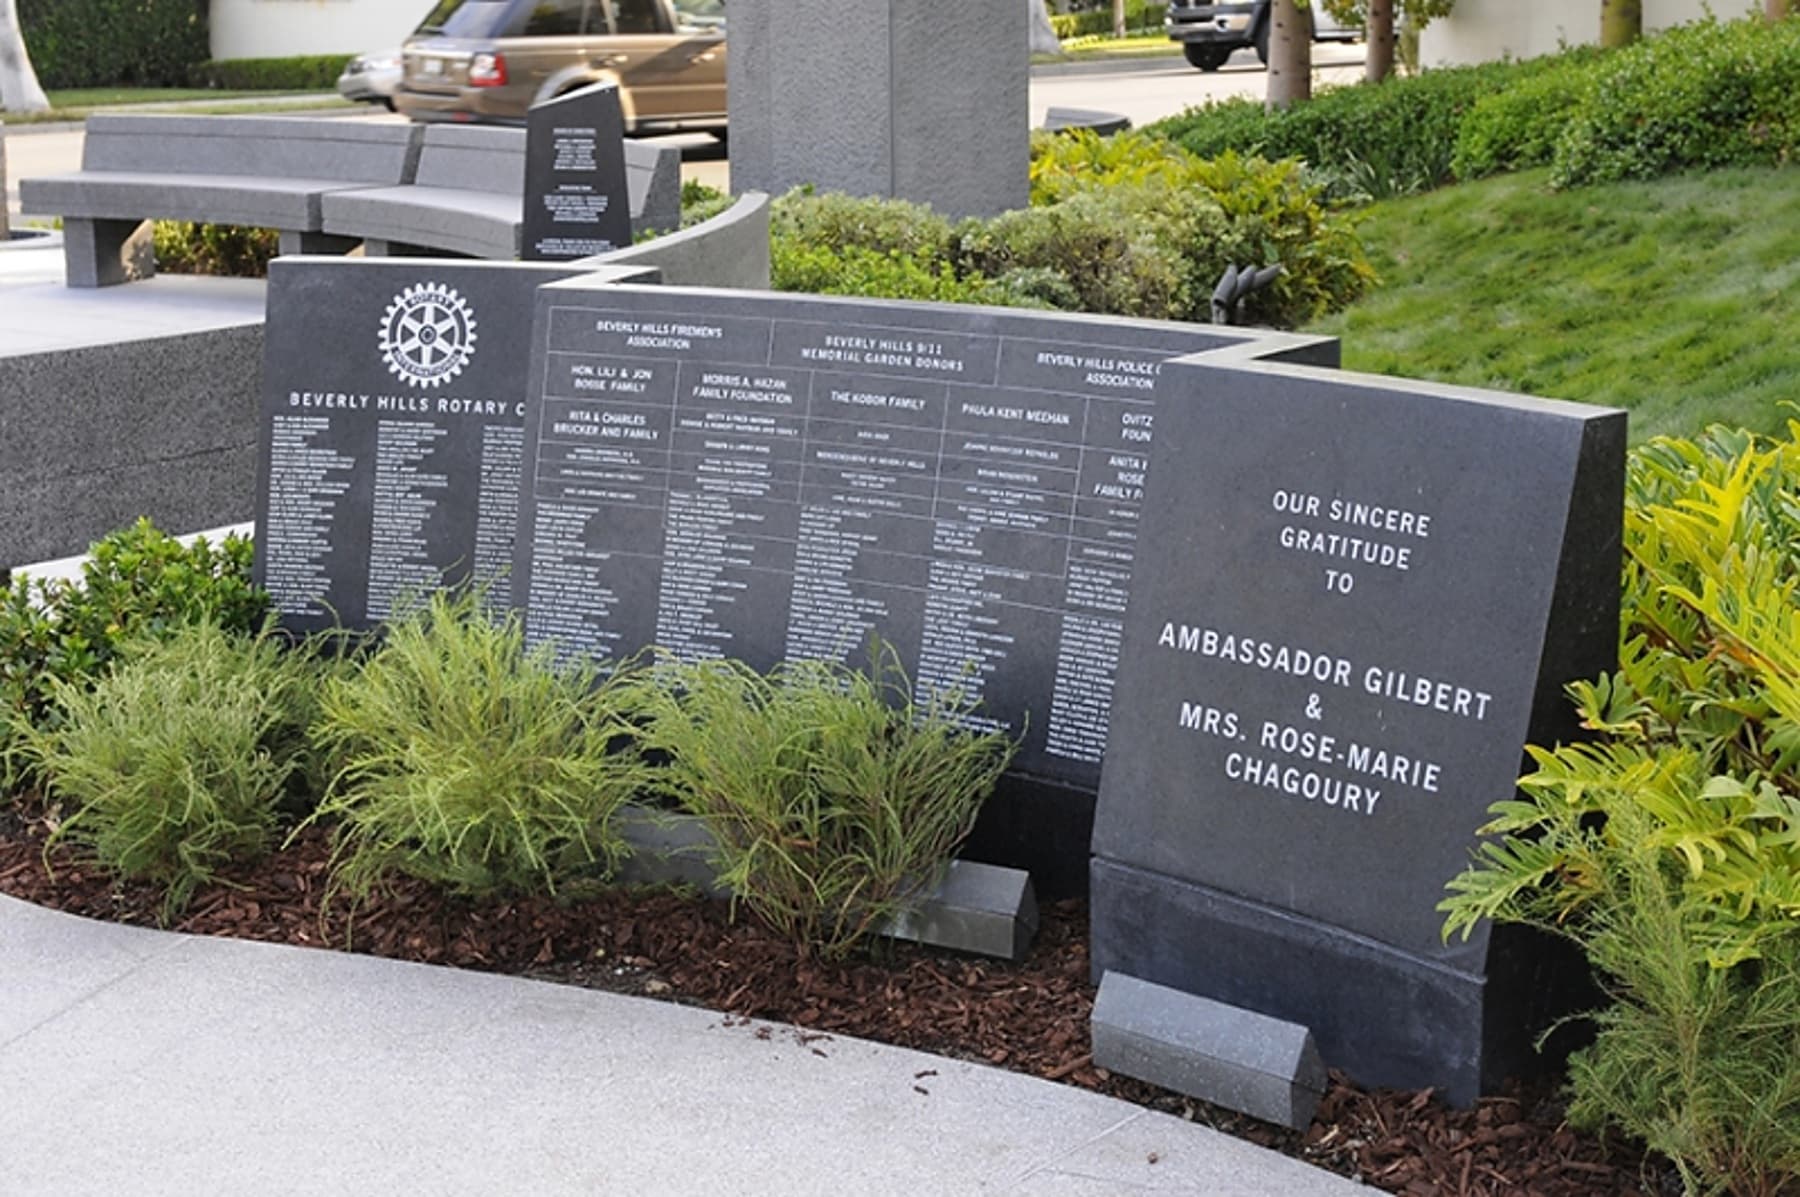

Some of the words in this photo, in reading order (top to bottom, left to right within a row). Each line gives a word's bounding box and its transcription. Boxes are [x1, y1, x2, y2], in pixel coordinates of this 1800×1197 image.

[597, 320, 639, 332] BEVERLY
[641, 323, 669, 335] HILLS
[627, 336, 690, 349] ASSOCIATION
[825, 335, 876, 349] BEVERLY
[879, 339, 913, 352] HILLS
[801, 347, 861, 363] MEMORIAL
[863, 352, 912, 367] GARDEN
[915, 356, 963, 372] DONORS
[1036, 352, 1082, 368] BEVERLY
[1084, 357, 1114, 371] HILLS
[1116, 360, 1153, 375] POLICE
[620, 368, 628, 378] &
[632, 369, 653, 380] JON
[702, 373, 740, 387] MORRIS
[753, 378, 787, 390] HAZAN
[1085, 372, 1154, 390] ASSOCIATION
[610, 381, 646, 393] FAMILY
[692, 386, 728, 400] FAMILY
[730, 389, 793, 404] FOUNDATION
[289, 391, 369, 409] BEVERLY
[377, 396, 429, 412] HILLS
[438, 398, 507, 416] ROTARY
[831, 390, 850, 404] THE
[888, 396, 926, 411] FAMILY
[569, 411, 591, 422] RITA
[593, 412, 600, 423] &
[602, 412, 646, 426] CHARLES
[962, 403, 995, 417] PAULA
[997, 407, 1024, 420] KENT
[1026, 410, 1070, 425] MEEHAN
[1122, 412, 1153, 427] OVITZ
[553, 422, 599, 436] BRUCKER
[601, 426, 621, 438] AND
[623, 427, 658, 440] FAMILY
[1108, 455, 1140, 469] ANITA
[1118, 472, 1145, 486] ROSE
[1093, 482, 1132, 498] FAMILY
[1272, 490, 1320, 517] OUR
[1328, 499, 1431, 538] SINCERE
[1280, 526, 1412, 570] GRATITUDE
[1325, 570, 1353, 594] TO
[1158, 622, 1352, 687] AMBASSADOR
[1364, 667, 1492, 720] GILBERT
[1305, 693, 1322, 720] &
[1179, 701, 1247, 742] MRS.
[1261, 721, 1442, 792] ROSE-MARIE
[1225, 752, 1381, 815] CHAGOURY
